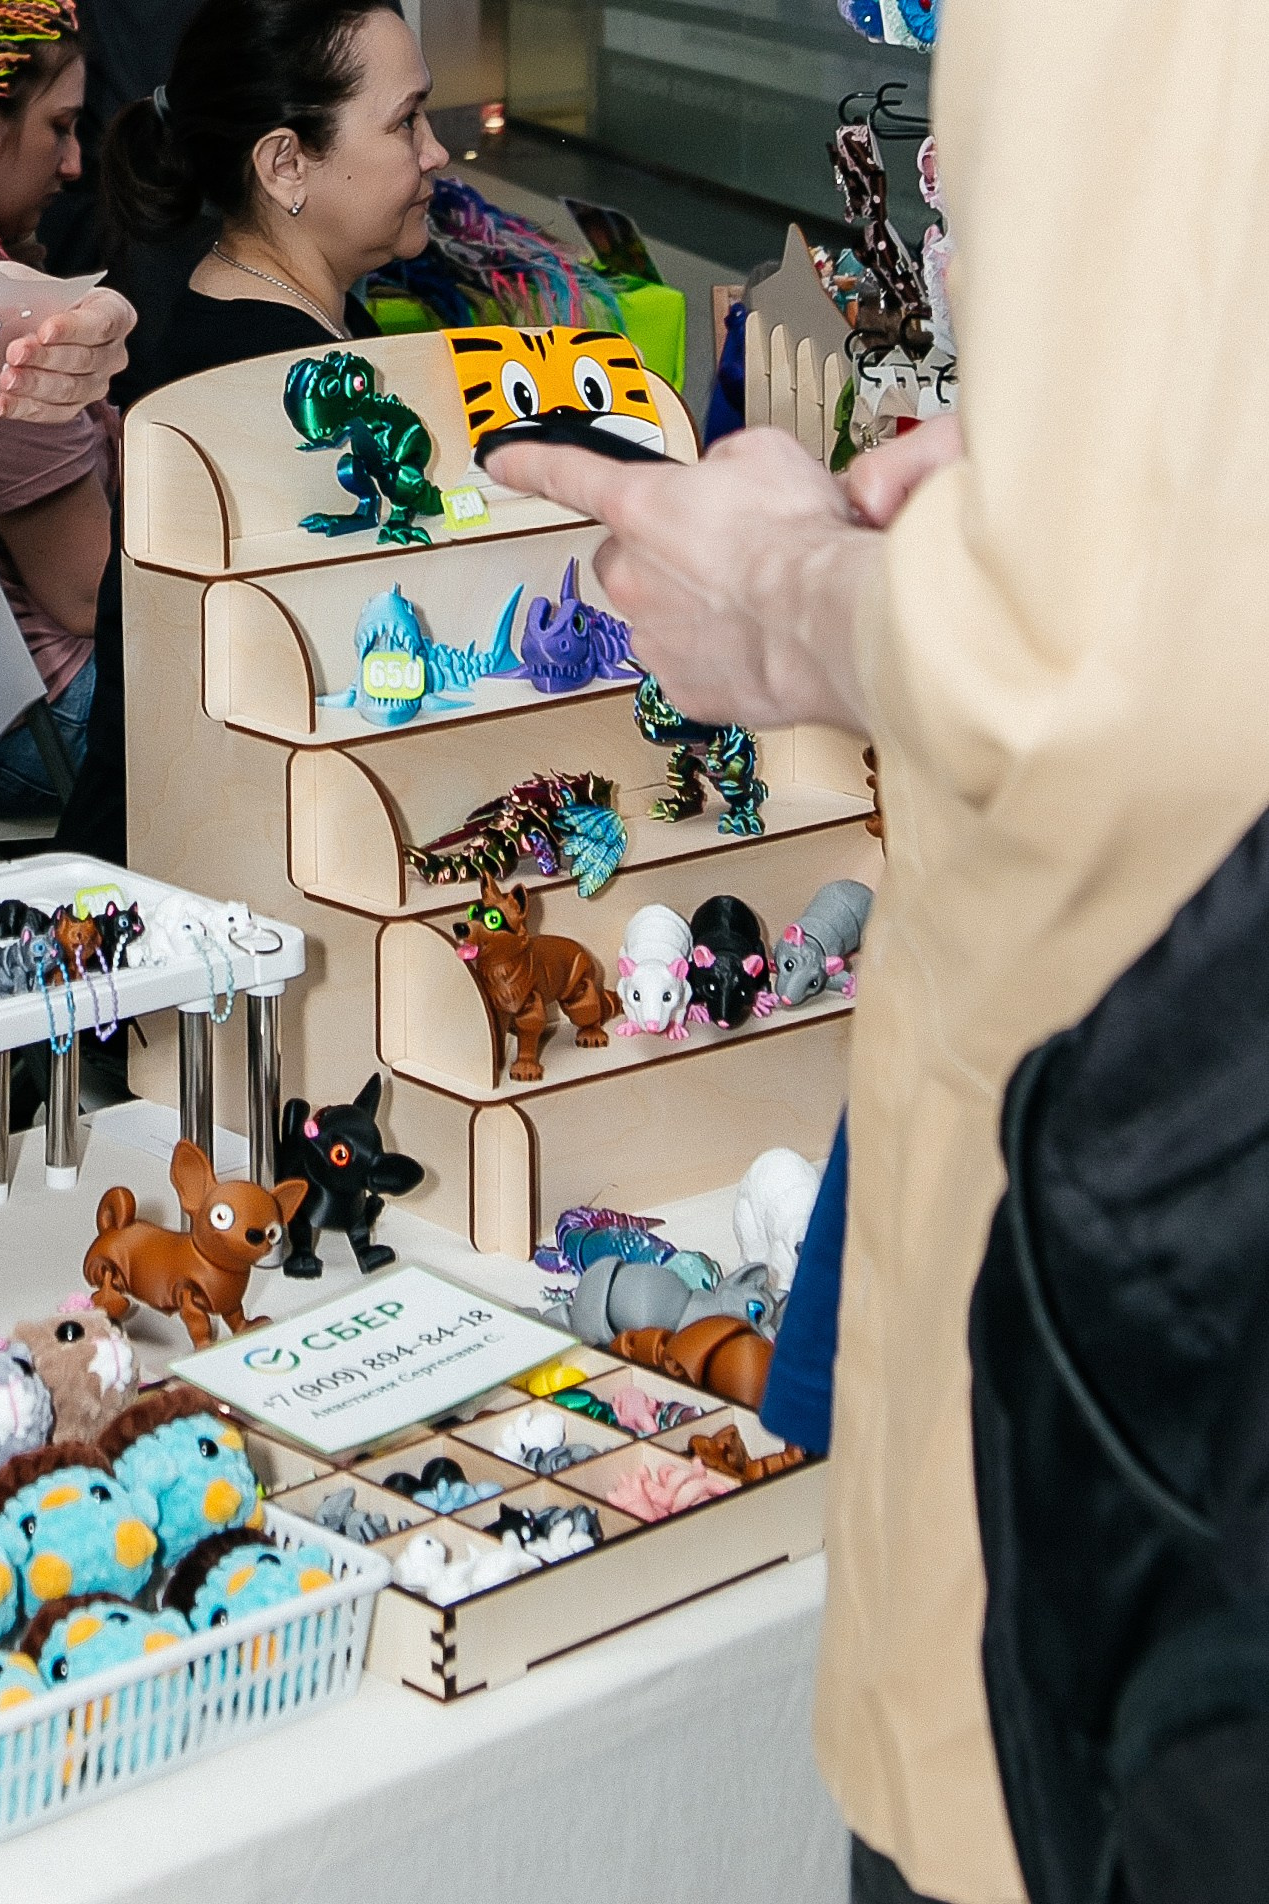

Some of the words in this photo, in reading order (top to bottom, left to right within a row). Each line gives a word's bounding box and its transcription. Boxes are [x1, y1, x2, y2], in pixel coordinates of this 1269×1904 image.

[370, 660, 421, 690] 650
[301, 1301, 404, 1350] СБЕР
[292, 1368, 369, 1402] (909)
[362, 1309, 493, 1371] 894-84-18
